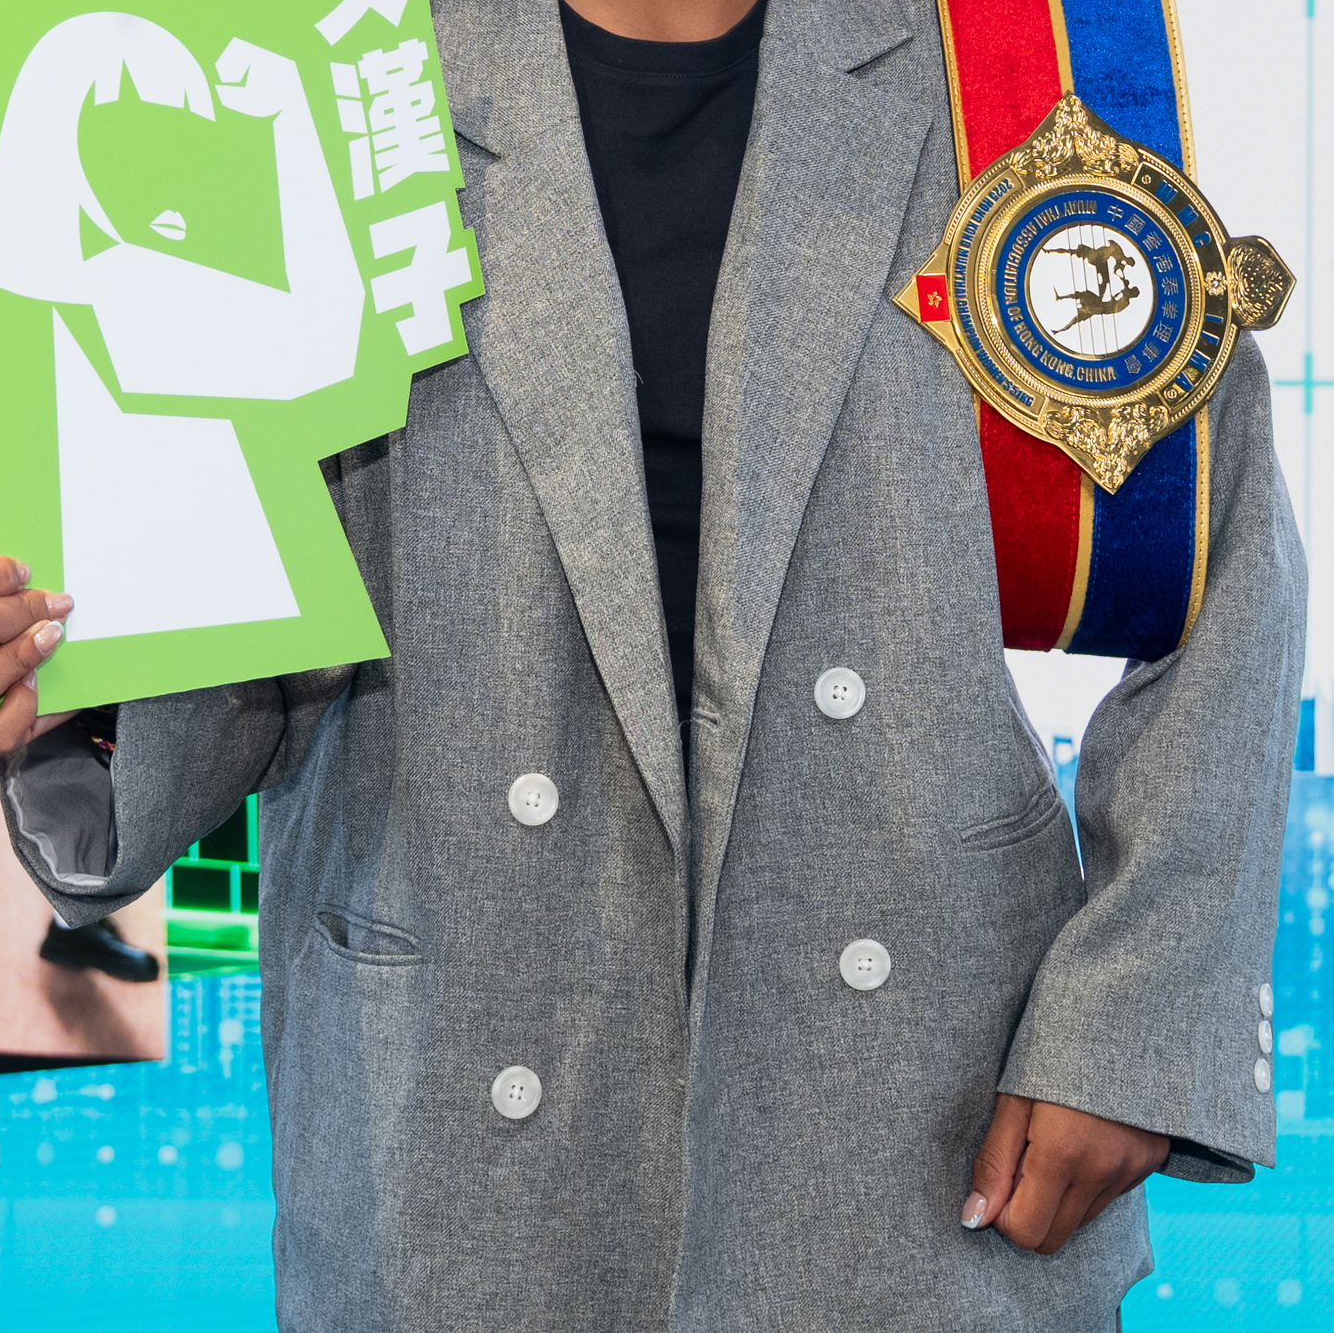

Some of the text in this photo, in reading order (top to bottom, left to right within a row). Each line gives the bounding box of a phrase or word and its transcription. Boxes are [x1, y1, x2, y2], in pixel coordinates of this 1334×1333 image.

[991, 178, 1013, 202] 2025
[974, 195, 995, 223] HONG
[1033, 204, 1065, 230] THAI
[1064, 199, 1098, 217] MUAY
[959, 219, 979, 248] KONG
[1003, 221, 1039, 305] ASSOCIATION
[1107, 204, 1179, 374] 中國香港泰拳理事會
[956, 300, 983, 352] CHAMPION
[1007, 305, 1024, 322] OF
[1013, 321, 1044, 359] HONG
[1174, 313, 1225, 392] IFMA
